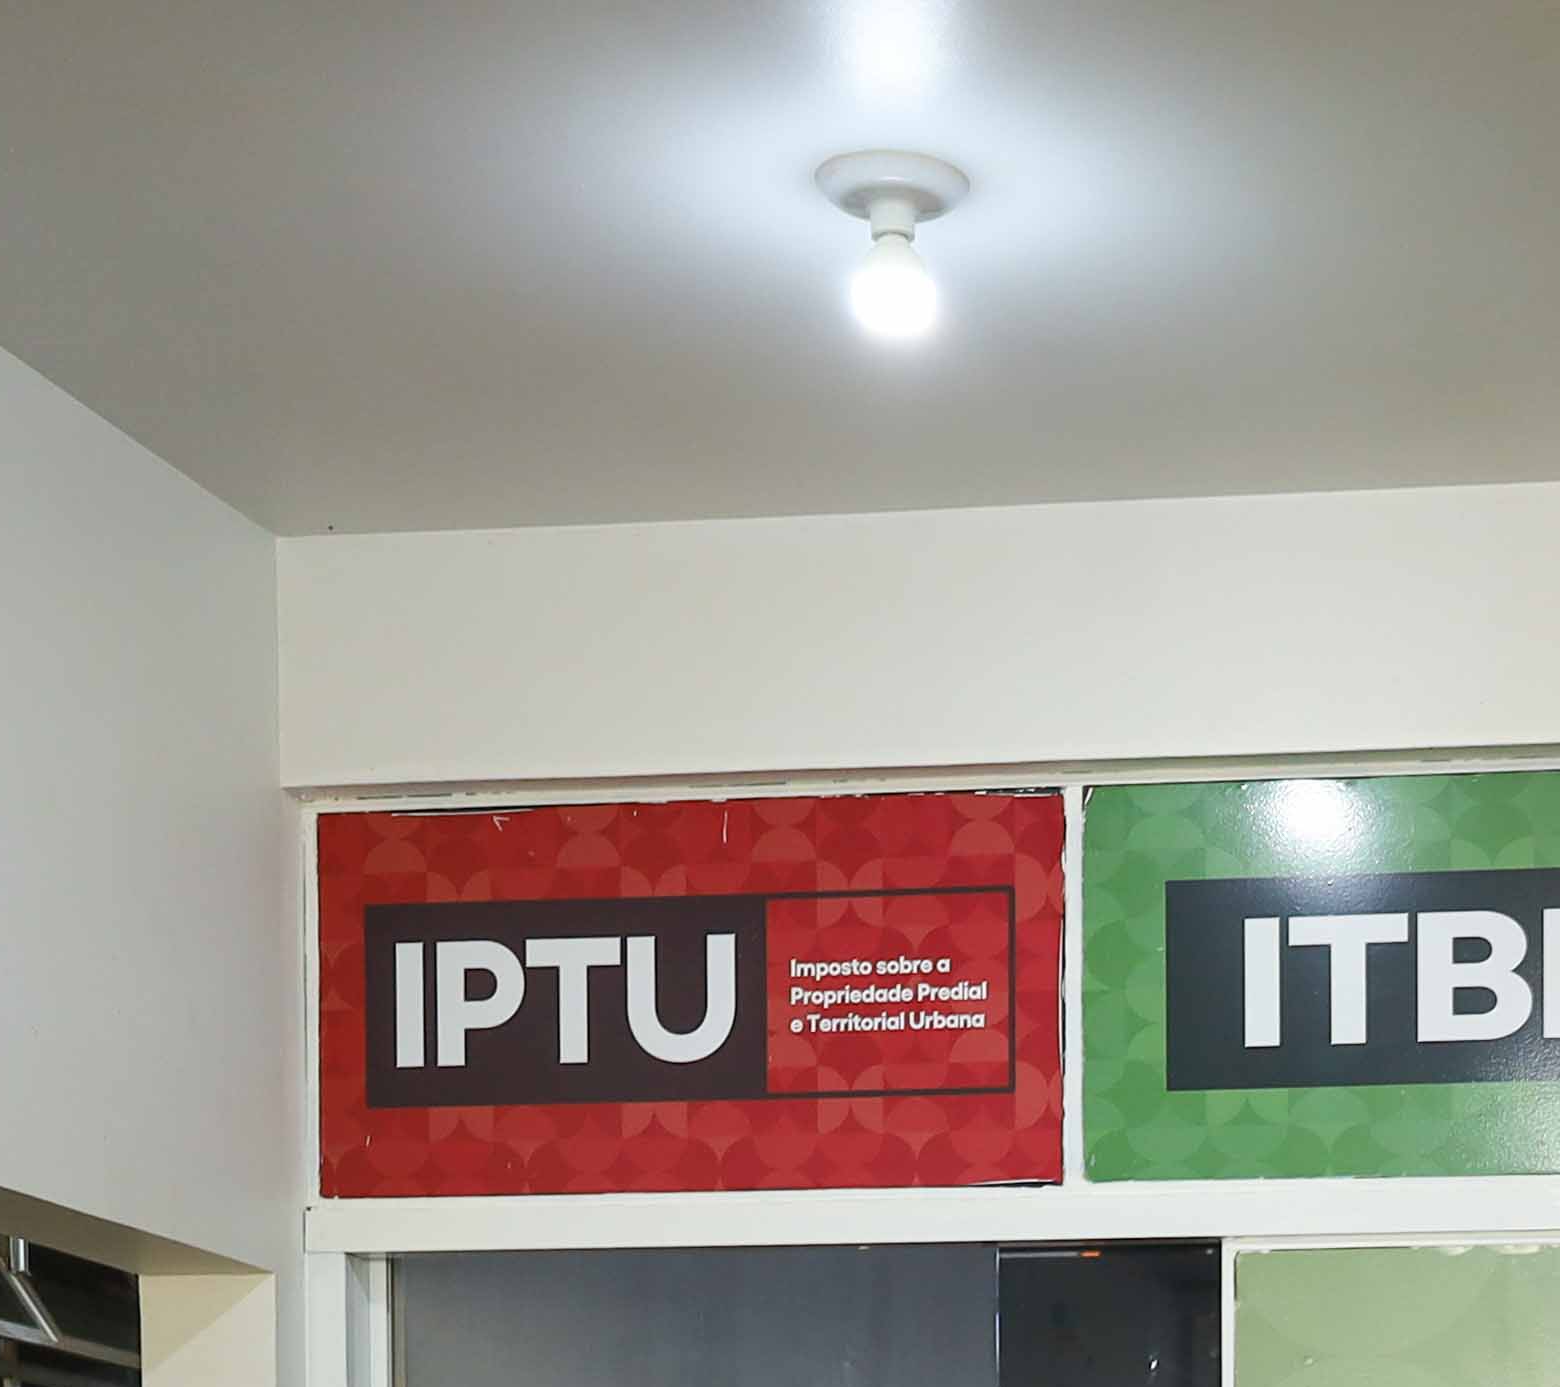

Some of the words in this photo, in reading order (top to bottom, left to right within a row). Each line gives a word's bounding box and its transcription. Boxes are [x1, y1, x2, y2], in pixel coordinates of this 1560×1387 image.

[790, 958, 872, 981] Imposto
[876, 956, 933, 974] sobre
[936, 958, 951, 973] a
[395, 932, 736, 1068] IPTU
[790, 983, 913, 1008] Propriedade
[917, 981, 987, 1002] Predial
[790, 1019, 803, 1033] e
[807, 1011, 904, 1033] Territorial
[909, 1011, 985, 1030] Urbana
